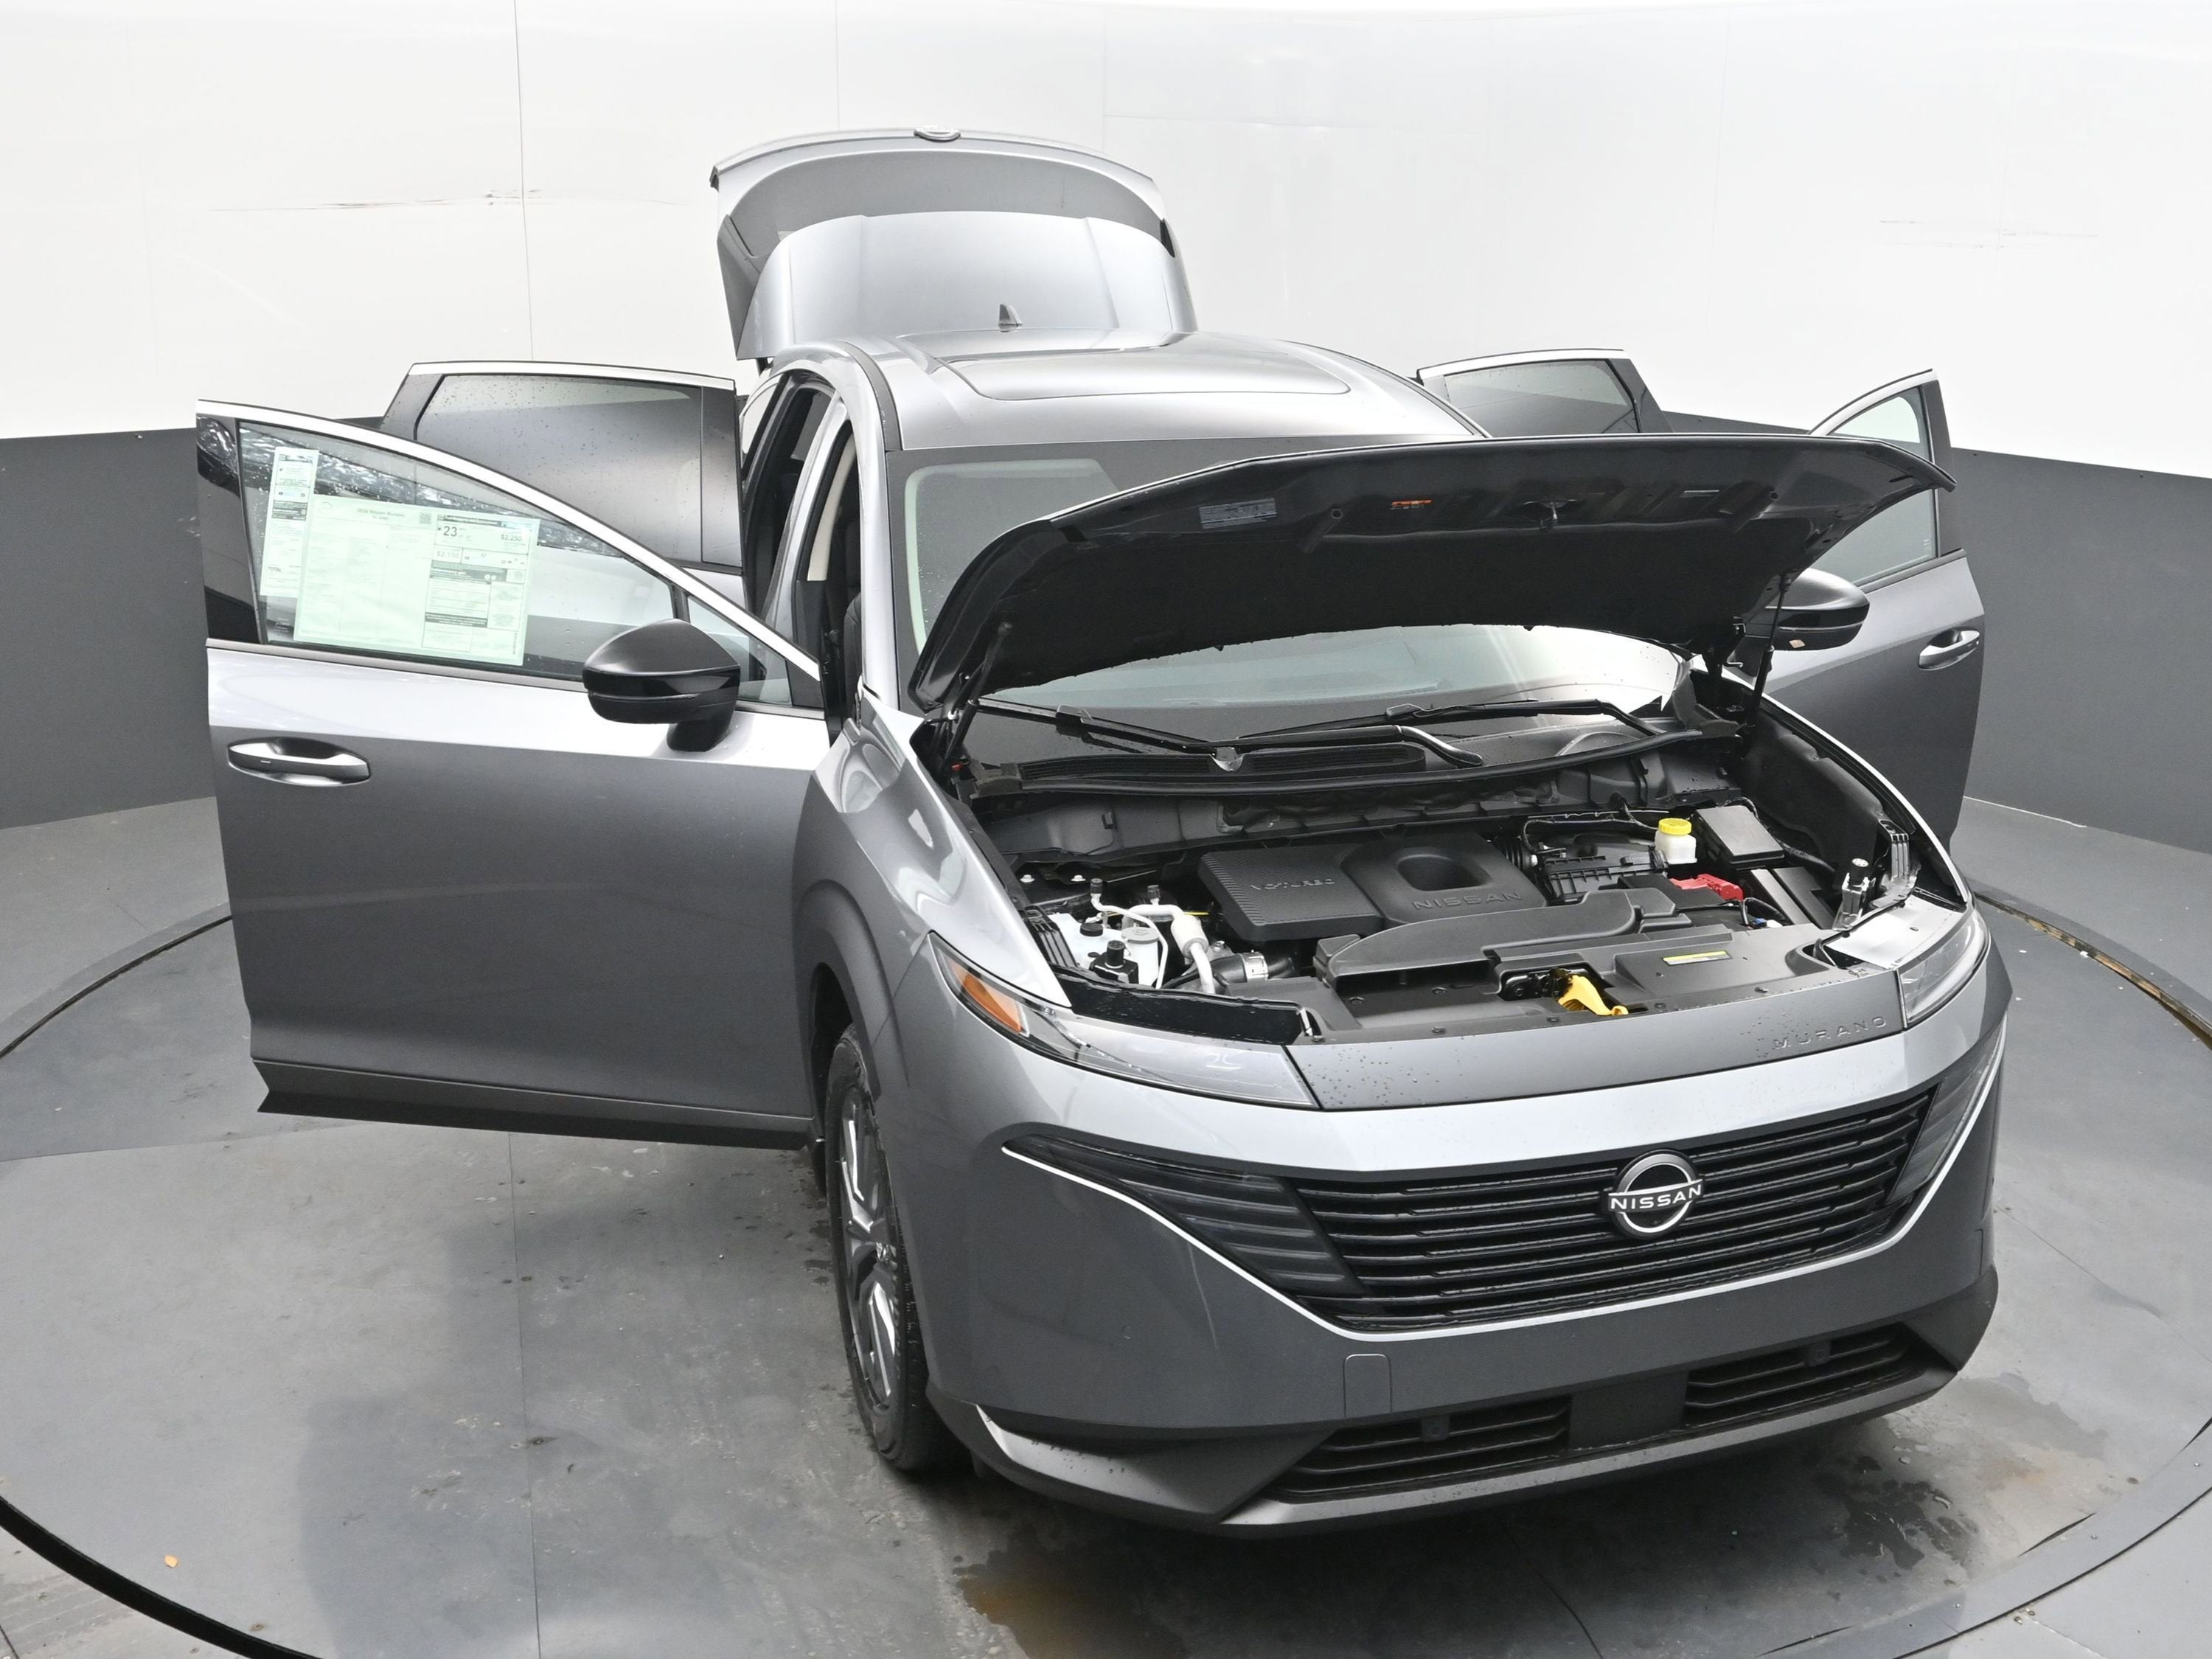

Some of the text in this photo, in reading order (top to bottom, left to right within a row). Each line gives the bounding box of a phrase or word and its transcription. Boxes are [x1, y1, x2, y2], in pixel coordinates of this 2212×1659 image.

[443, 526, 458, 537] 23
[1411, 891, 1523, 911] NISSAN
[1772, 1015, 1887, 1050] MURANO
[1610, 1183, 1702, 1210] NISSAN
